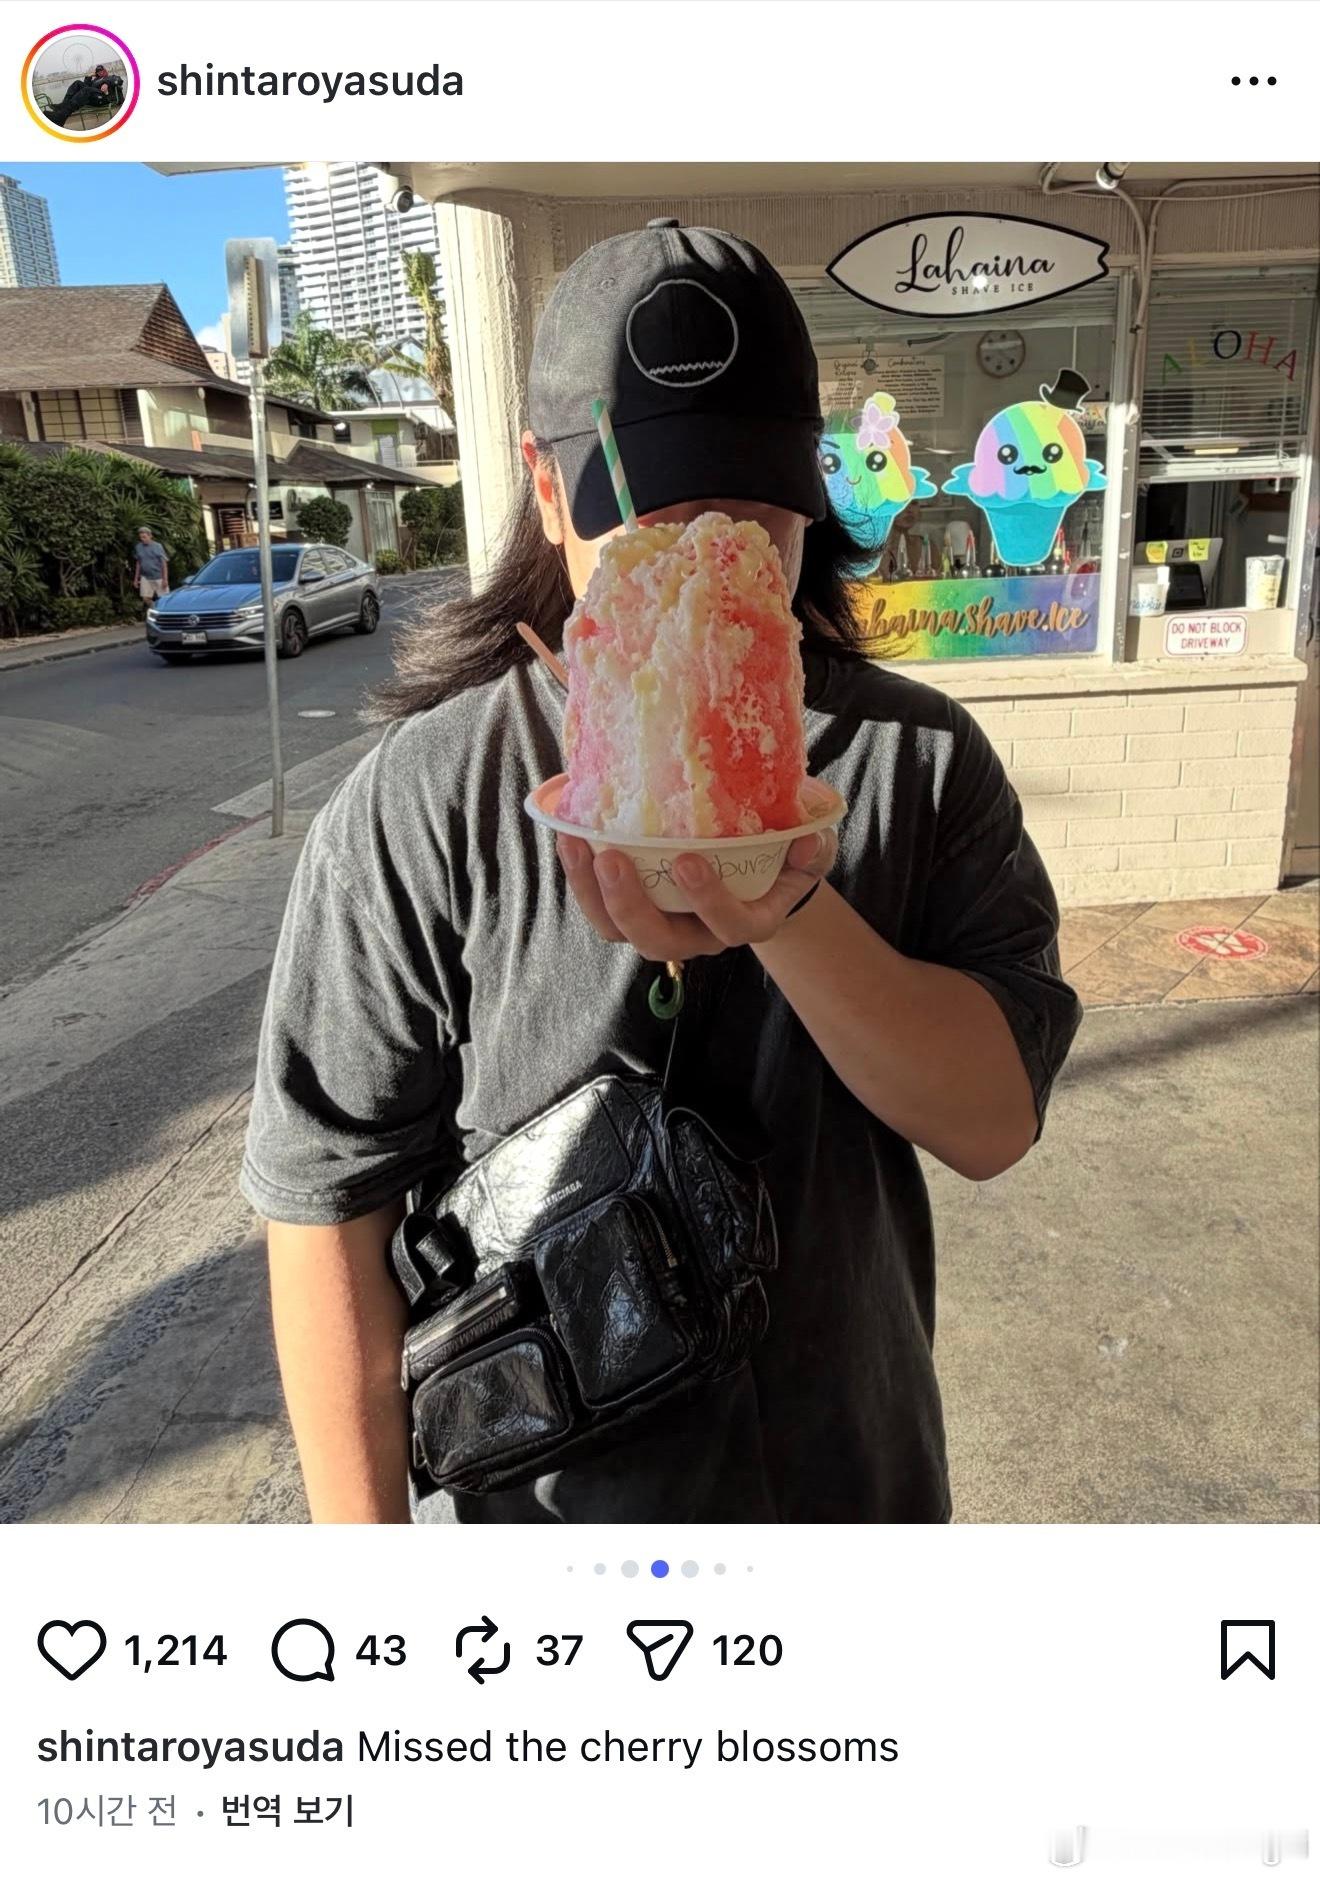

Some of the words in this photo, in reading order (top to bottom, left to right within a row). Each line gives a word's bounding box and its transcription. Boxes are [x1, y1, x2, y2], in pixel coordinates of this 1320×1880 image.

[894, 225, 1056, 293] Lahaina
[951, 284, 1001, 296] SHAVE
[1010, 282, 1035, 293] ICE
[1160, 329, 1298, 385] ALOHA
[1172, 623, 1185, 634] DO
[1188, 622, 1207, 633] NOT
[1210, 622, 1242, 633] BLOCK
[1181, 637, 1231, 649] DRIVEWAY
